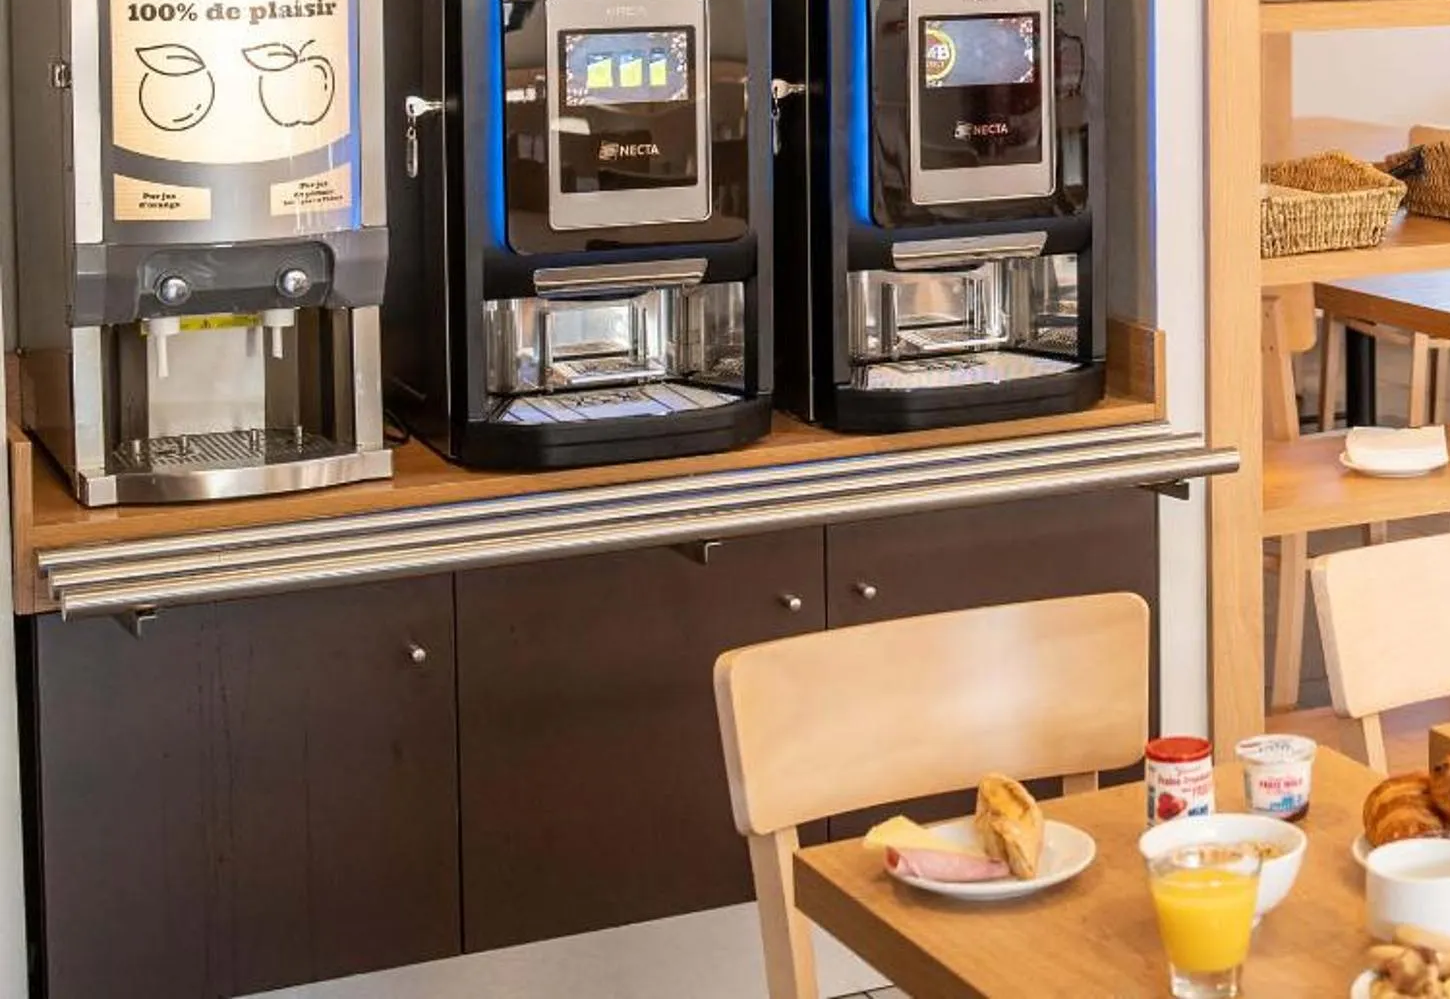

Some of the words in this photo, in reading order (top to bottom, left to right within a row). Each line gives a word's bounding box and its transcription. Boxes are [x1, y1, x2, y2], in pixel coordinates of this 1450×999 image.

[128, 2, 198, 22] 100%
[206, 2, 241, 21] de
[973, 123, 1009, 136] NECTA
[619, 144, 661, 157] NECTA
